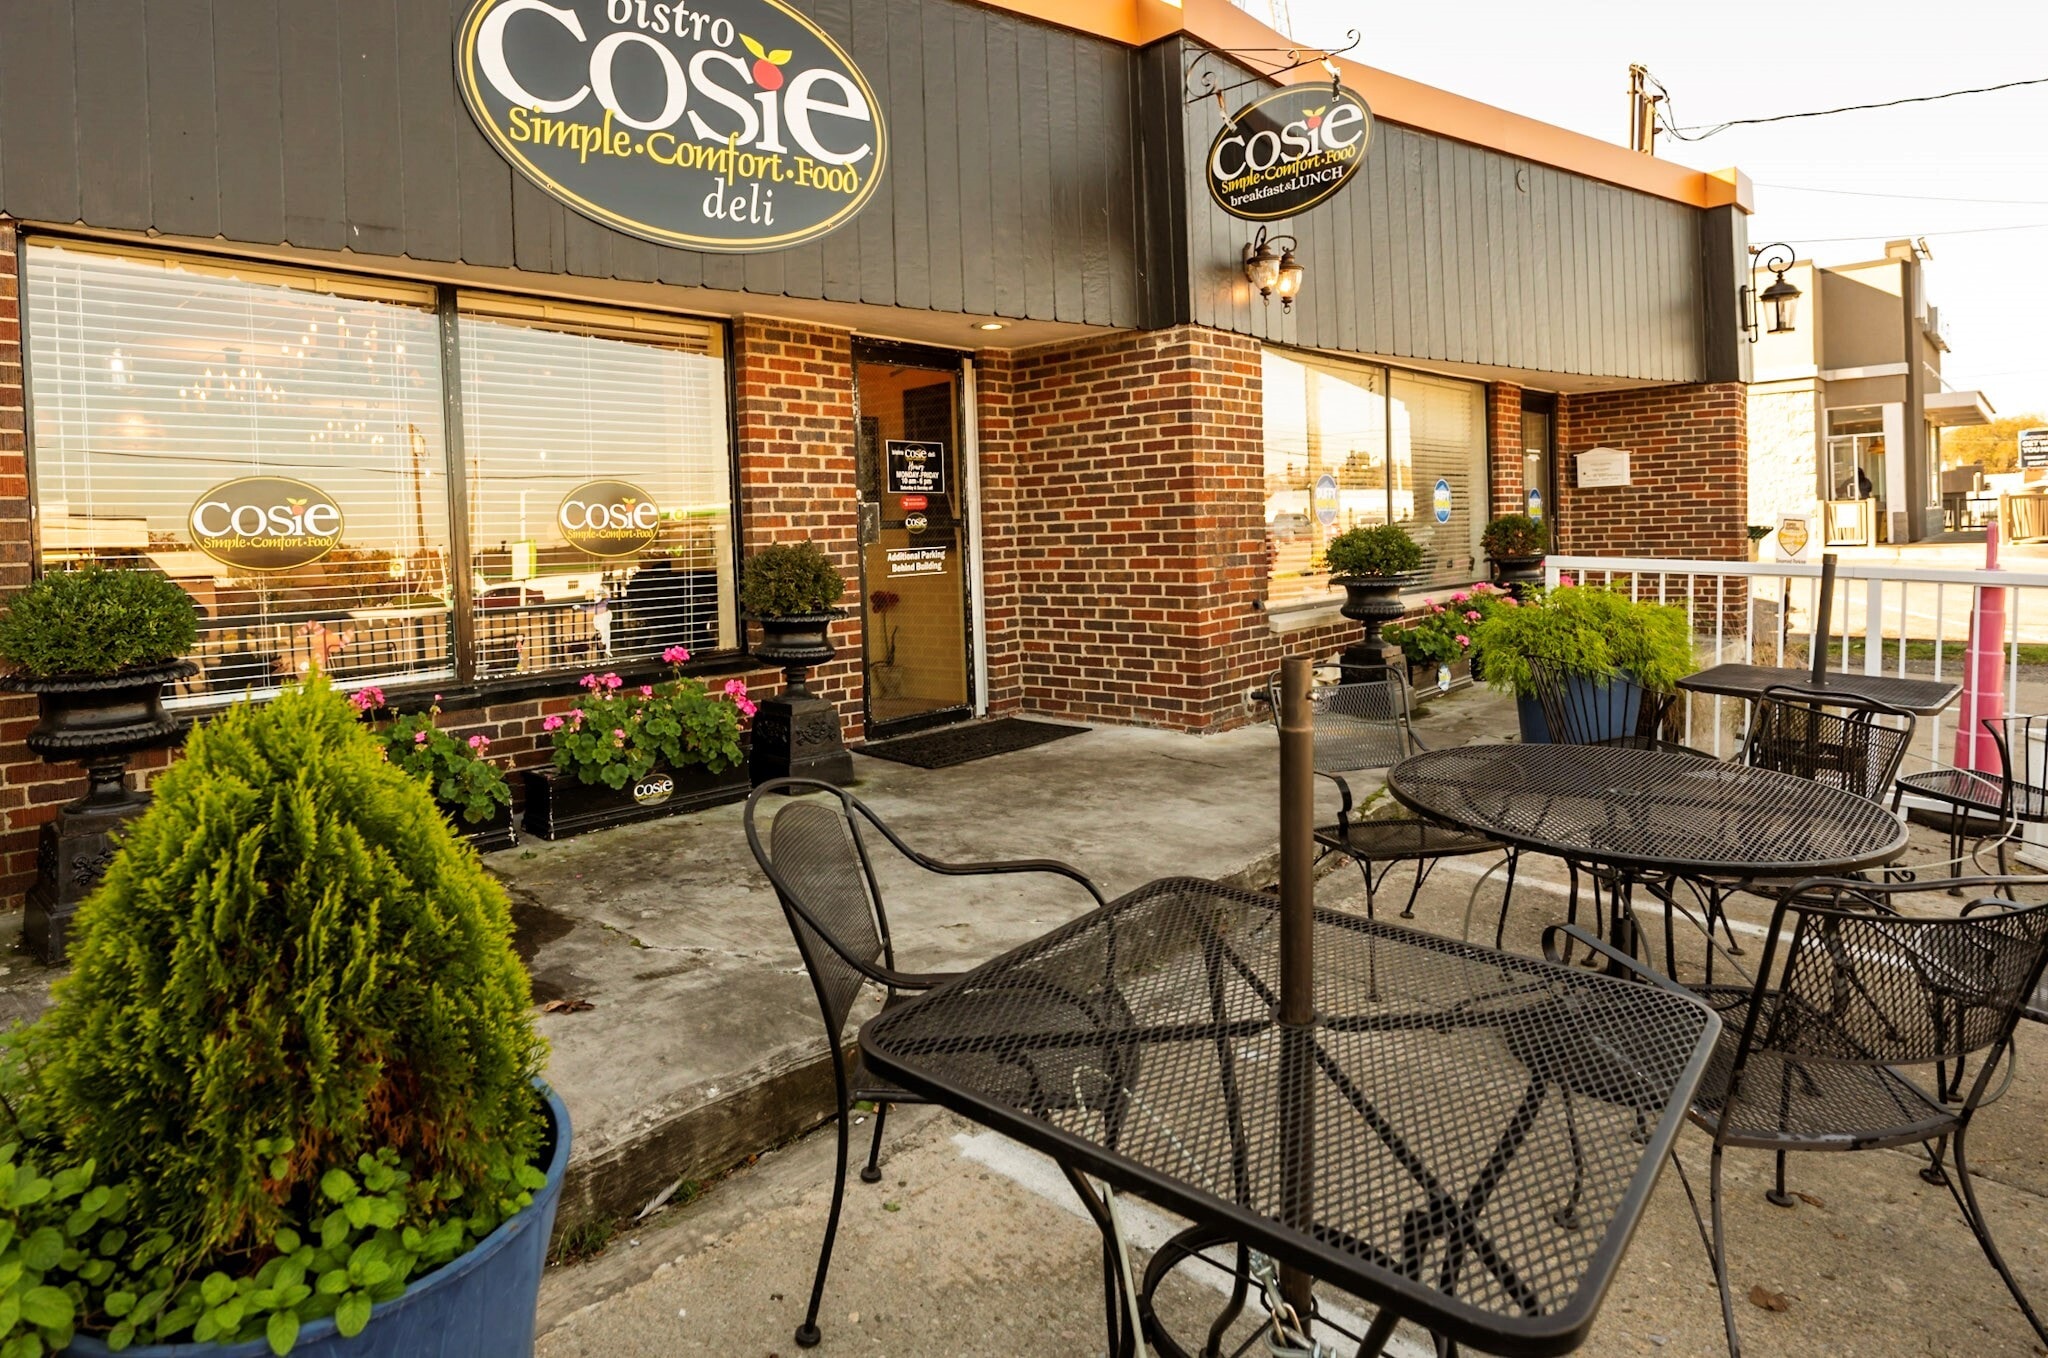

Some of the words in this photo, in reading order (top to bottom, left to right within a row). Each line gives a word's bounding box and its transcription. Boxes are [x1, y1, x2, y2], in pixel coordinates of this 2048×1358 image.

[607, 0, 735, 47] bistro
[509, 105, 631, 163] Simple
[647, 132, 784, 186] Comfort
[794, 156, 859, 194] Food
[1221, 167, 1261, 194] Simple
[1264, 153, 1321, 180] Comfort
[1324, 143, 1356, 165] Food
[702, 178, 774, 226] deli
[203, 533, 247, 551] Simple
[250, 535, 303, 551] Comfort
[306, 535, 334, 547] Food
[887, 551, 920, 561] Additional
[920, 550, 946, 560] Parking
[892, 562, 915, 573] Behind
[915, 561, 942, 572] Building
